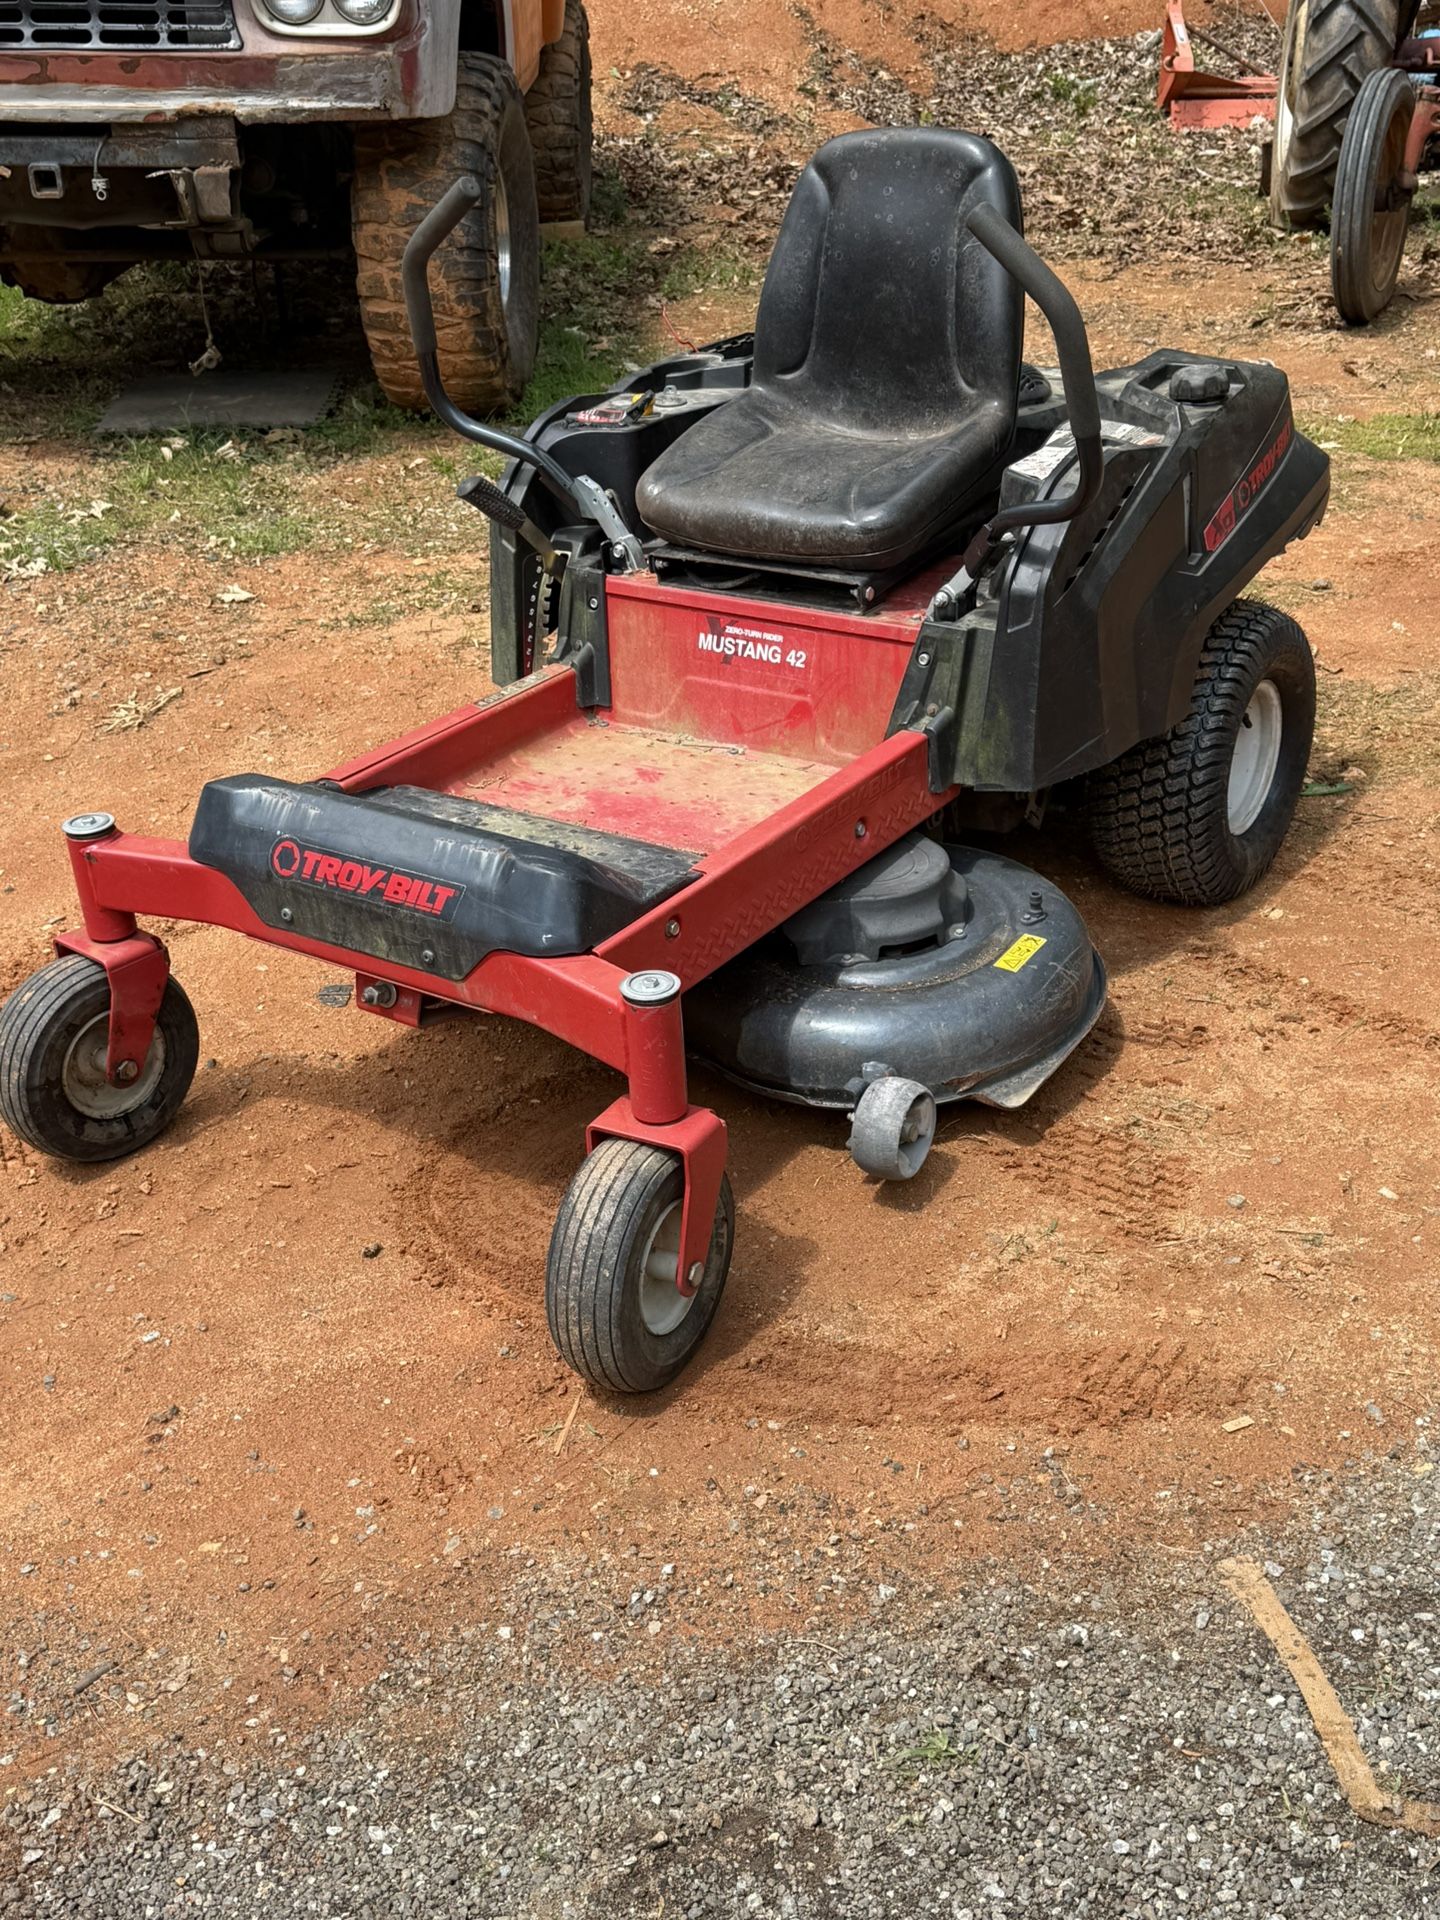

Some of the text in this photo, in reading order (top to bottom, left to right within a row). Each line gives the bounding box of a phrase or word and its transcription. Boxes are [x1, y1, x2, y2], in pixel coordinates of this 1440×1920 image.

[698, 632, 807, 668] MUSTANG 42
[725, 625, 783, 643] ZERO-TURN RIDER
[302, 850, 455, 915] TROY-BILT
